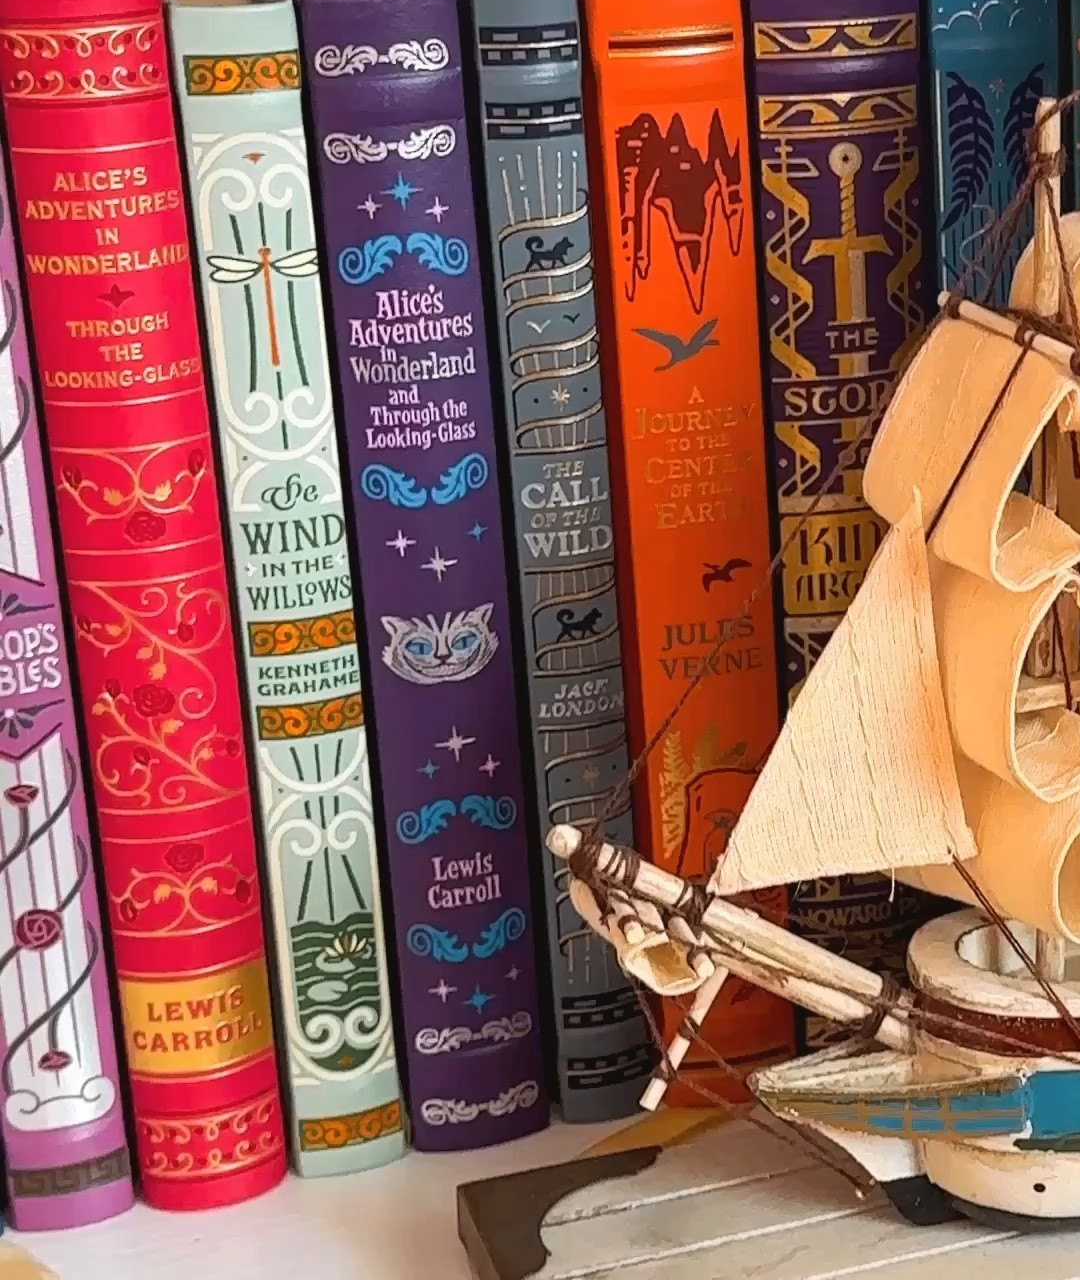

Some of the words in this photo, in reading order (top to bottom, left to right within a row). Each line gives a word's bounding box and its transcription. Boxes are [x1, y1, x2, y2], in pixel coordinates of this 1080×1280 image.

[52, 166, 148, 193] ALICE'S
[24, 189, 181, 220] ADVENTURES
[95, 227, 120, 247] IN
[26, 242, 189, 277] WONDERLAND
[375, 283, 445, 319] Alice's
[66, 311, 170, 339] THROUGH
[348, 314, 474, 348] Adventures
[825, 326, 880, 350] THE
[99, 342, 145, 364] THE
[350, 348, 476, 386] Wonderland
[379, 345, 398, 363] in
[45, 357, 202, 389] LOOKING-GLASS
[388, 385, 421, 406] and
[688, 385, 705, 405] A
[370, 402, 441, 428] Through
[441, 397, 468, 419] the
[365, 421, 476, 451] Looking-Glass
[666, 437, 691, 453] TO
[542, 459, 585, 480] THE
[260, 472, 320, 512] The
[520, 475, 609, 510] CALL
[670, 484, 692, 499] OF
[239, 512, 346, 556] WIND
[530, 509, 560, 530] OF
[523, 525, 614, 560] WILD
[260, 560, 287, 580] IN
[291, 554, 336, 575] THE
[246, 573, 354, 612] WILLOWS
[0, 622, 59, 661] OP'S
[662, 618, 757, 653] JULES
[257, 653, 356, 682] KENNETH
[658, 645, 763, 681] VERNE
[256, 669, 360, 699] GRAHAME
[552, 678, 610, 703] JACK
[538, 688, 625, 720] LONDON
[433, 851, 494, 883] Lewis
[428, 873, 502, 910] Carroll
[147, 983, 246, 1024] LEWIS
[132, 1011, 265, 1053] CARROLL
